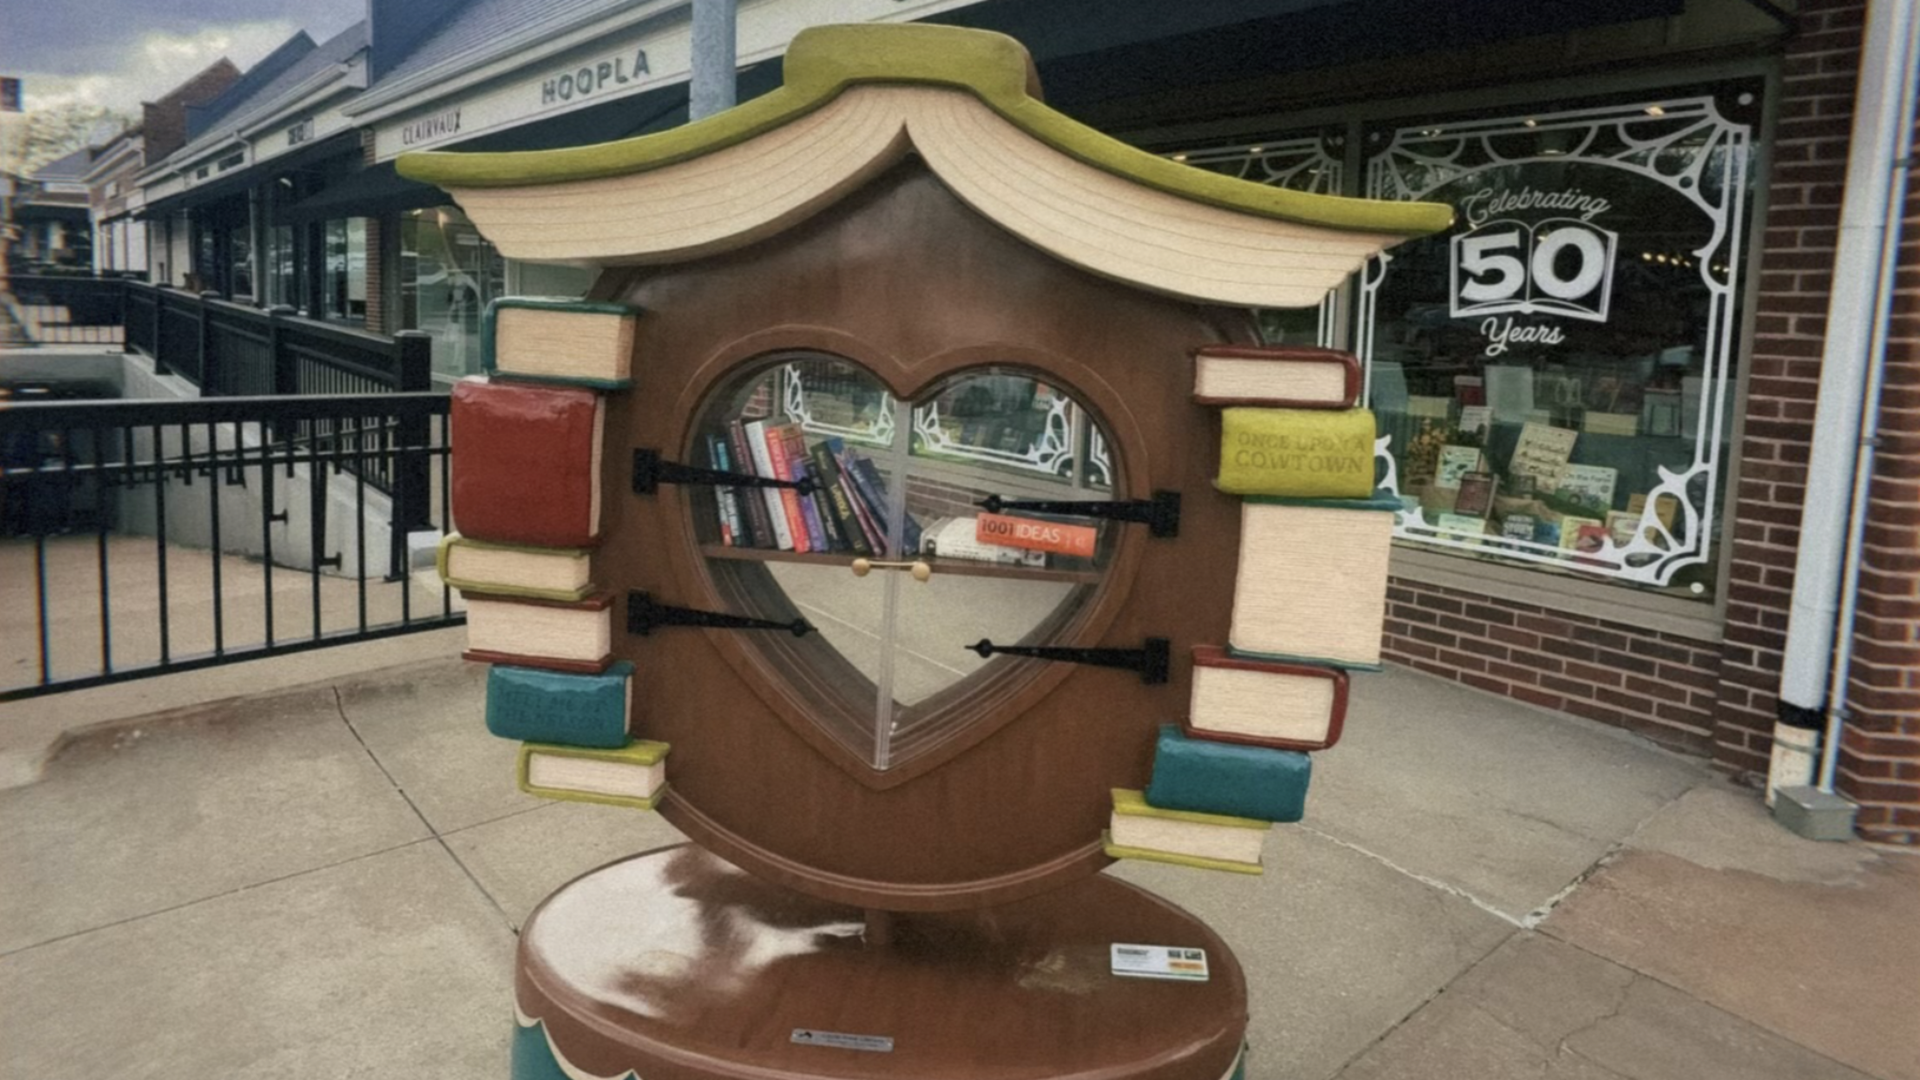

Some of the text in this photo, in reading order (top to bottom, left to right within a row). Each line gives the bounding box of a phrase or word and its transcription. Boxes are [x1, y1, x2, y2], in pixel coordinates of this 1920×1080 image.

[541, 49, 652, 105] HOOPLA
[402, 107, 462, 145] CLAIRVAUX
[1461, 186, 1612, 224] Celebrating
[1459, 227, 1606, 301] 50
[1480, 316, 1566, 357] Years
[1237, 431, 1290, 450] ONCE
[1235, 450, 1364, 474] COWTOWN
[981, 518, 1014, 537] 1001
[1015, 523, 1061, 544] IDEAS
